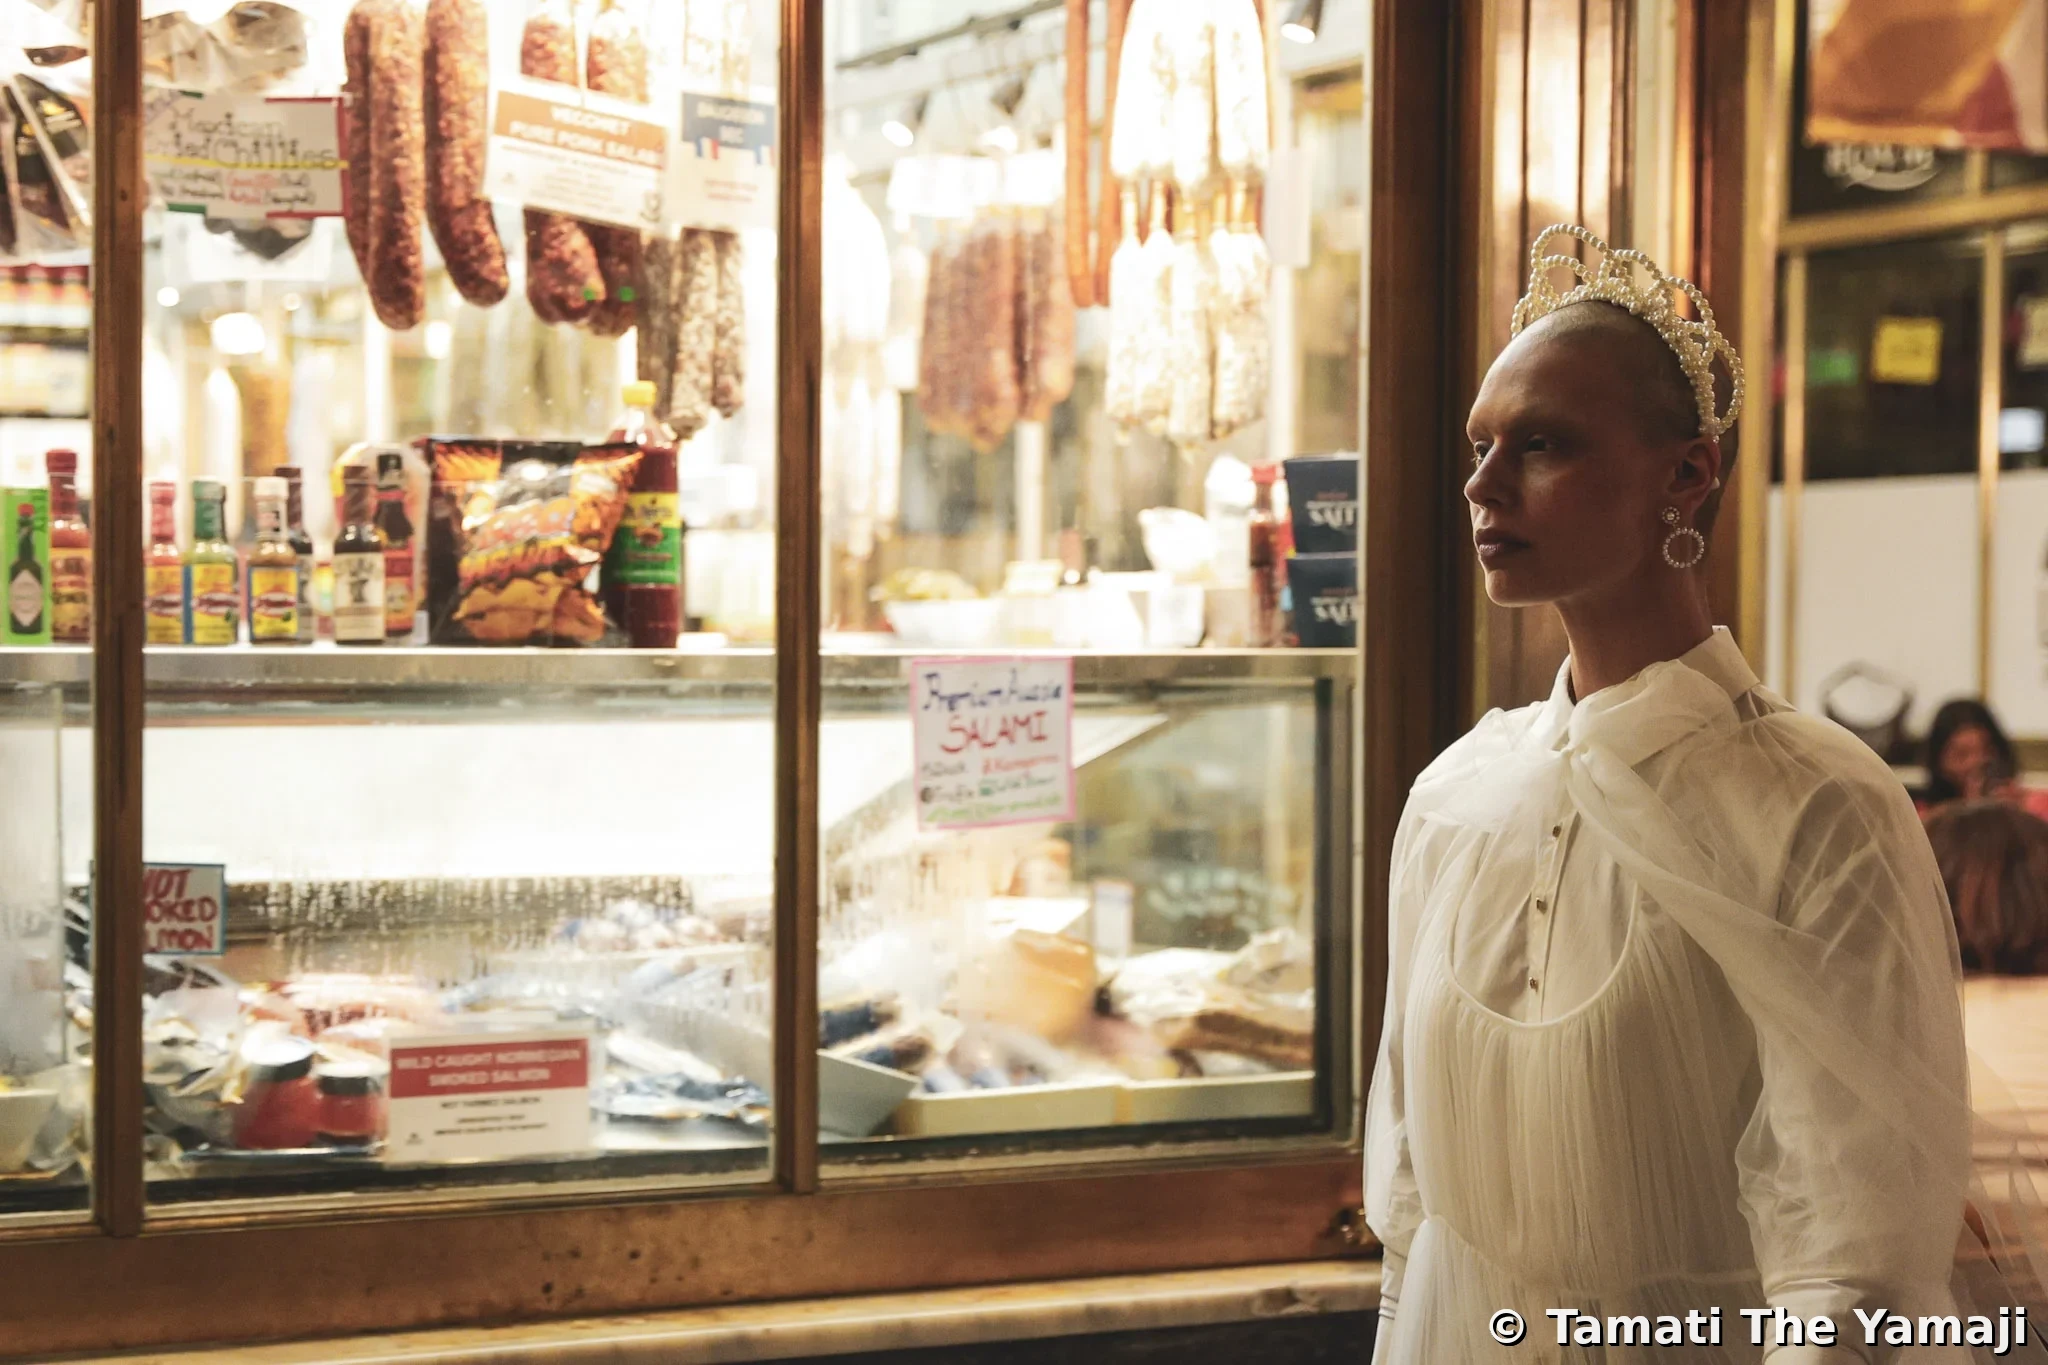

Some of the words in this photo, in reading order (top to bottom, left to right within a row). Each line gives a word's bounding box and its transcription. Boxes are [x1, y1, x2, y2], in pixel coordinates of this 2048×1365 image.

[940, 709, 1048, 753] SALAMI
[143, 897, 218, 924] OKED
[143, 926, 213, 952] LMON
[492, 1068, 551, 1084] SALMON
